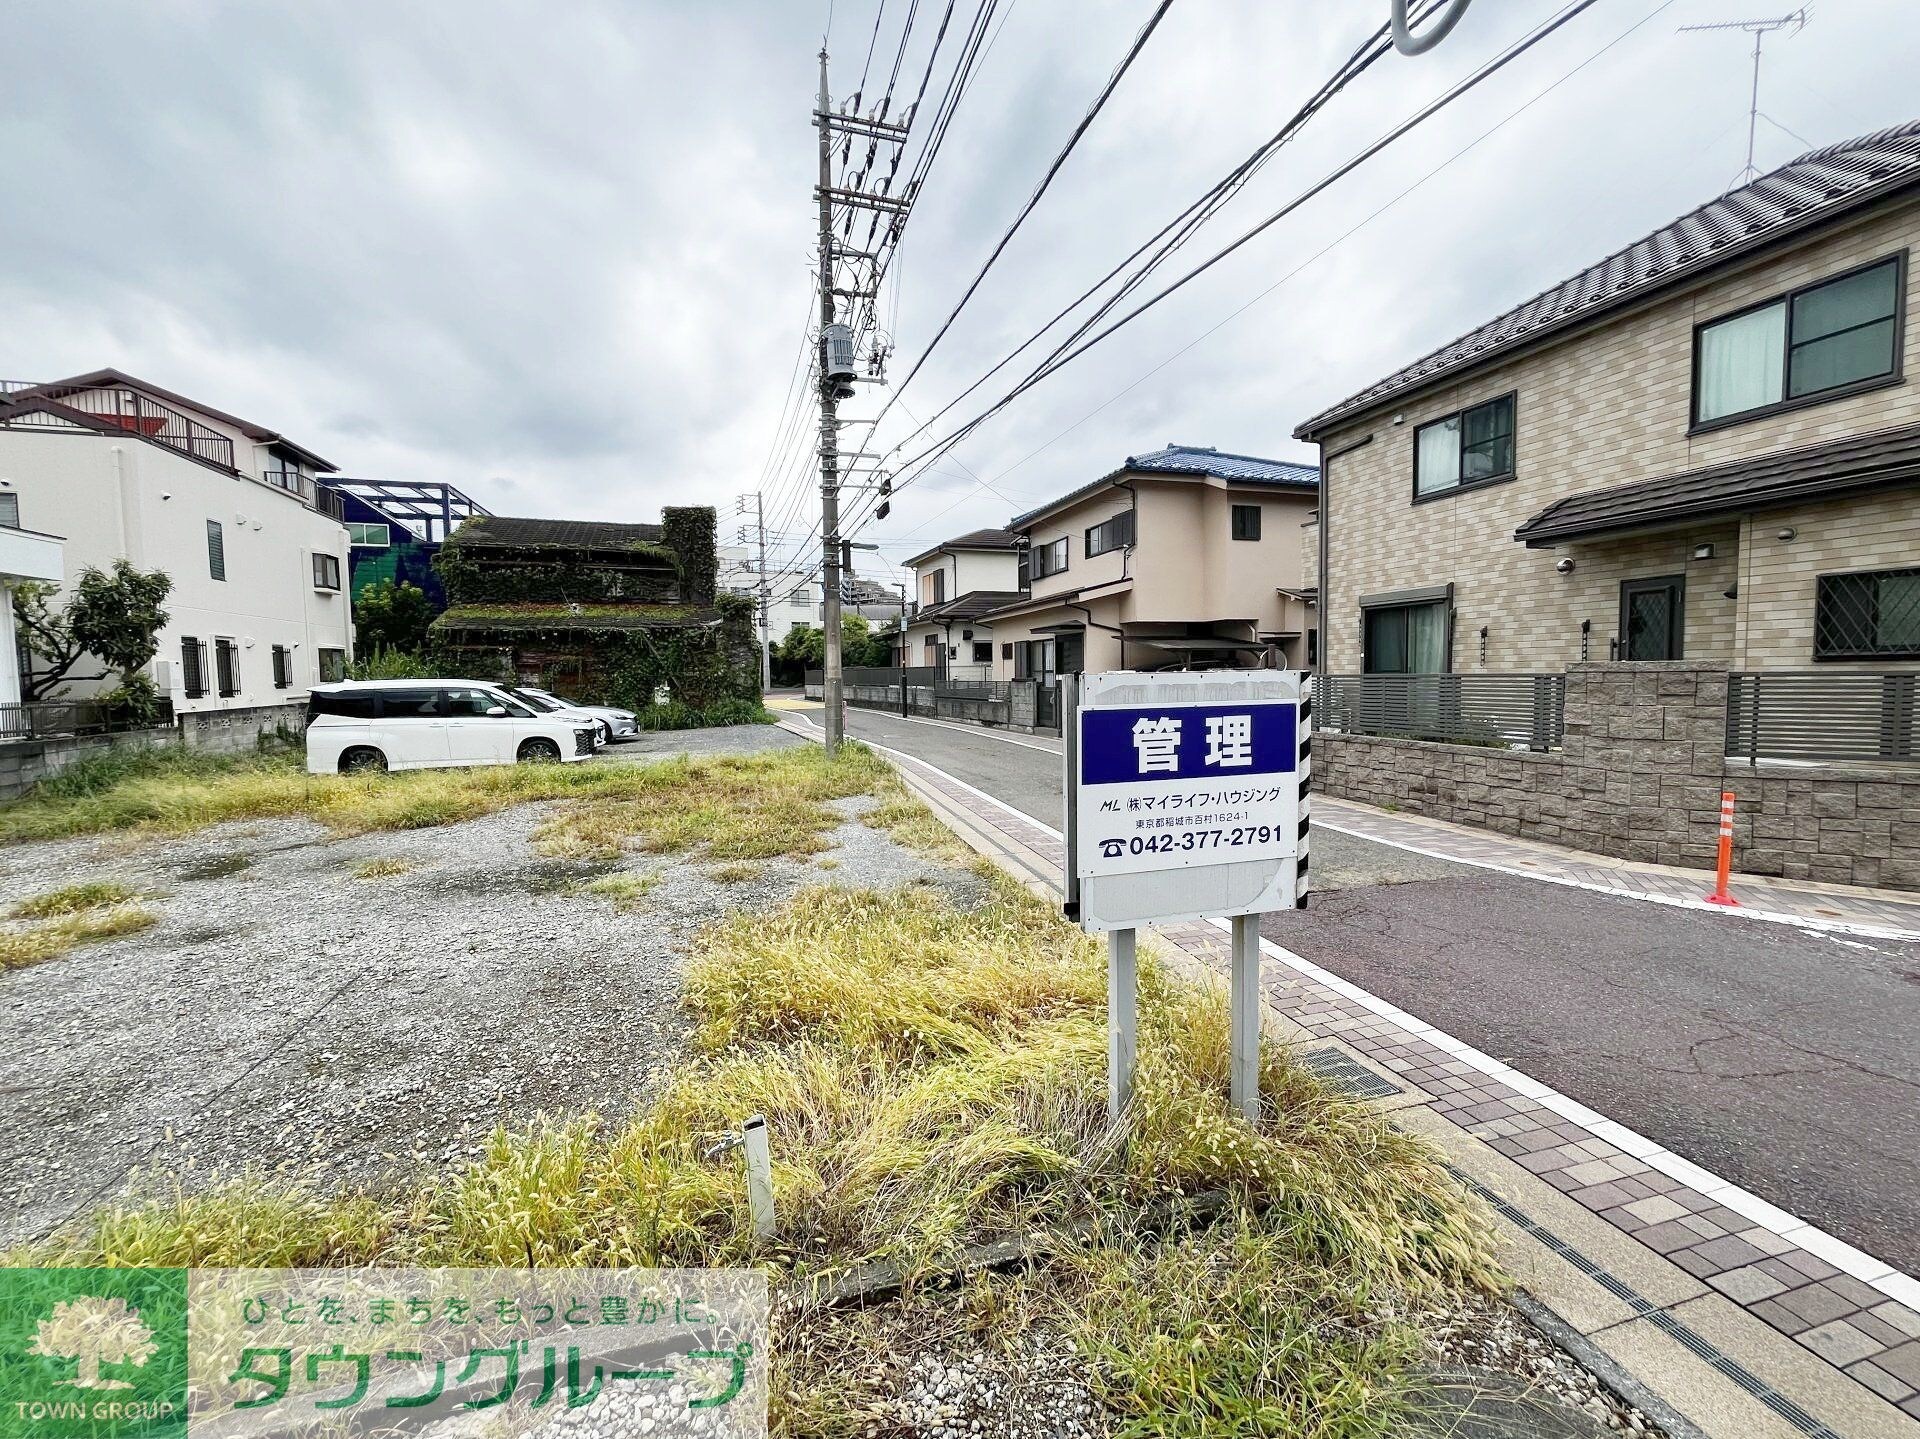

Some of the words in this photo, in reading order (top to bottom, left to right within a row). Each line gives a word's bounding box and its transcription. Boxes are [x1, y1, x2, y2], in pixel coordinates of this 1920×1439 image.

[1132, 715, 1253, 774] 管理
[1135, 811, 1249, 830] 東京都稲城市百村1624-1
[1129, 824, 1282, 855] 042-377-2791
